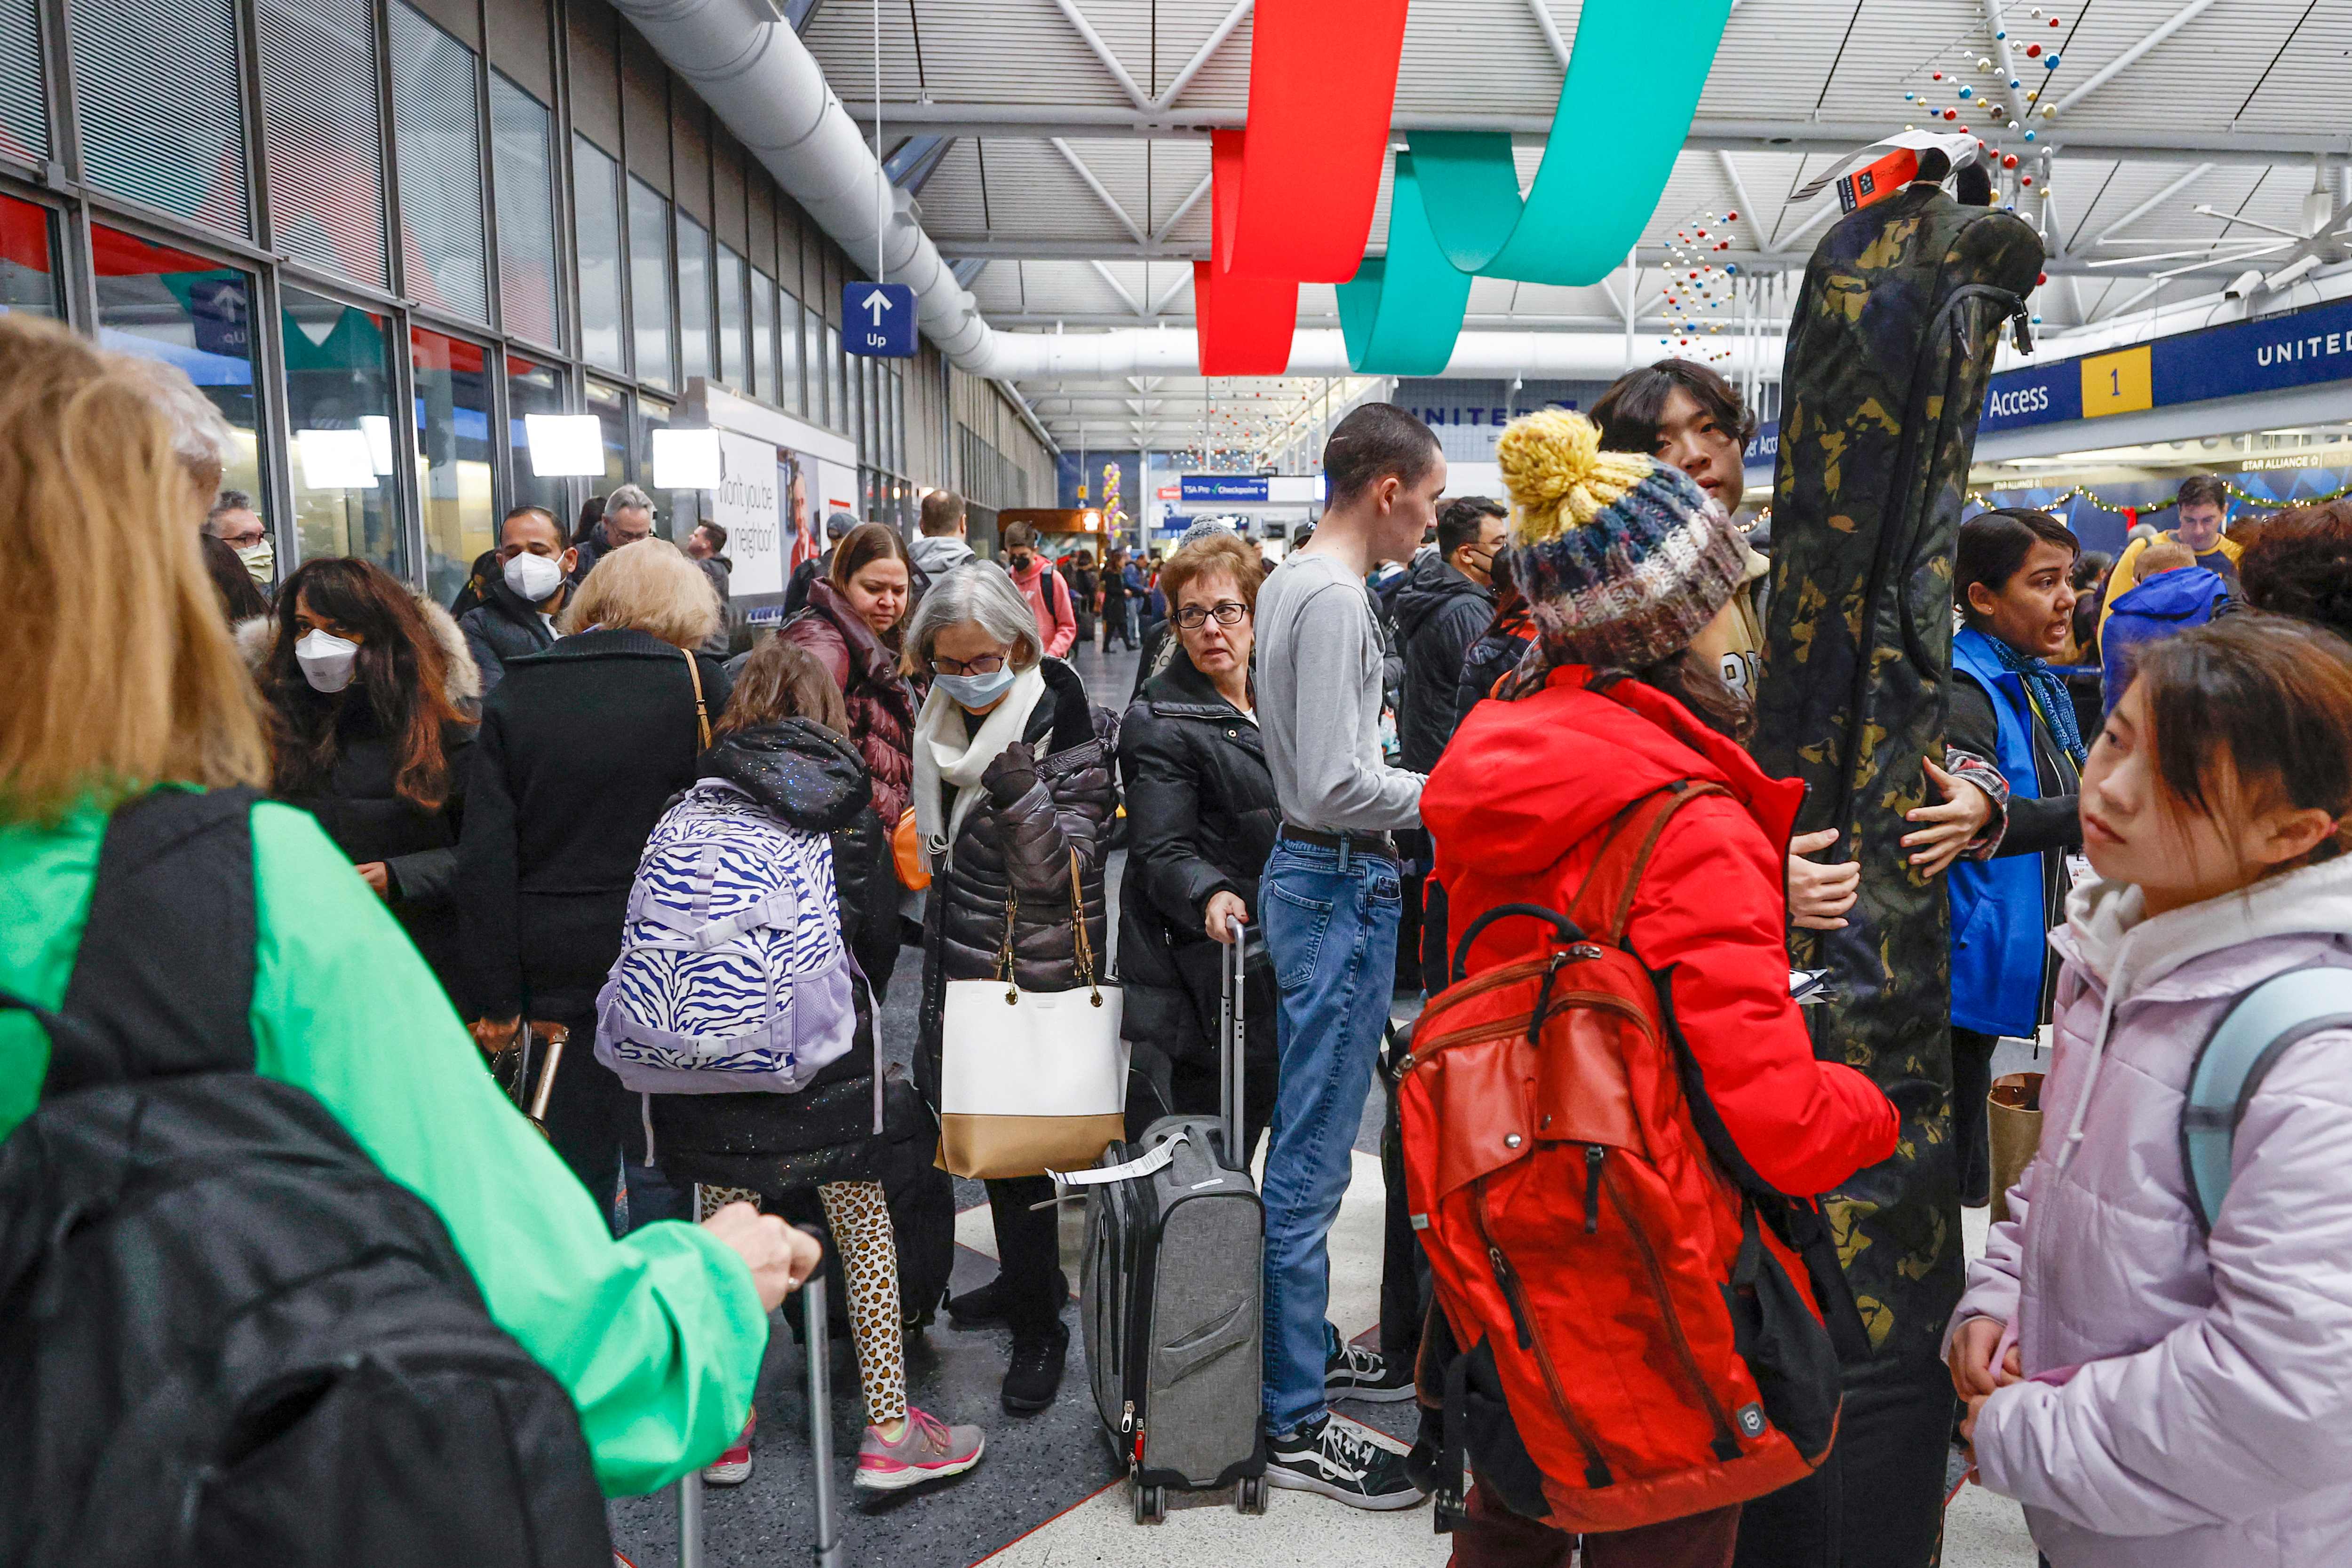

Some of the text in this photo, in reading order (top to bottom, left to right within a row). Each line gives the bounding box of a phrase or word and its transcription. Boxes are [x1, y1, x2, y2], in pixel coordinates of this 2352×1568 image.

[867, 333, 886, 348] Up
[2111, 368, 2121, 396] 1
[1989, 386, 2049, 418] Access
[2242, 459, 2264, 471] STAR
[2265, 455, 2308, 469] ALLIANCE
[2008, 478, 2034, 489] ALLIANCE
[744, 483, 760, 514] you
[734, 521, 776, 560] neighbor?
